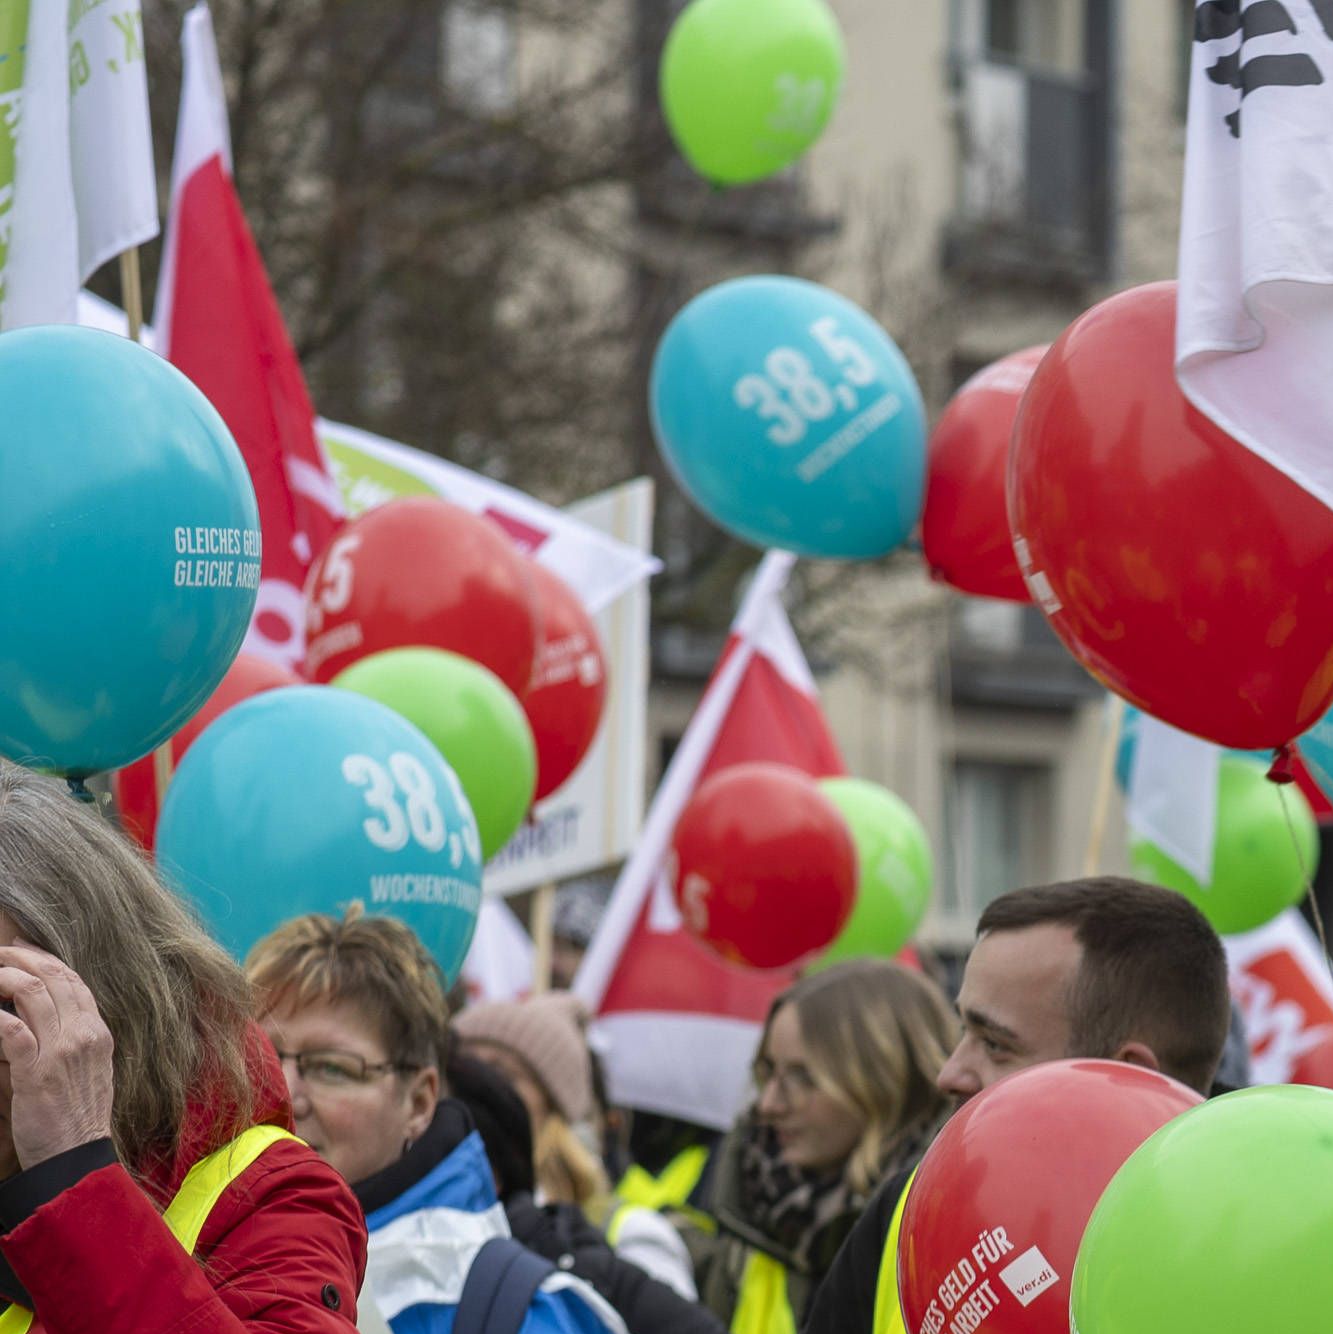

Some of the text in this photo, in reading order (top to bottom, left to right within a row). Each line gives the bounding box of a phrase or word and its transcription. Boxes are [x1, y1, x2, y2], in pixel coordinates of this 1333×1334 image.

[733, 316, 876, 447] 38,5
[175, 527, 241, 555] GLEICHES
[175, 560, 234, 586] GLEICHE
[938, 1258, 976, 1311] GELD
[971, 1226, 1014, 1273] FÜR
[1016, 1269, 1051, 1296] ver.di
